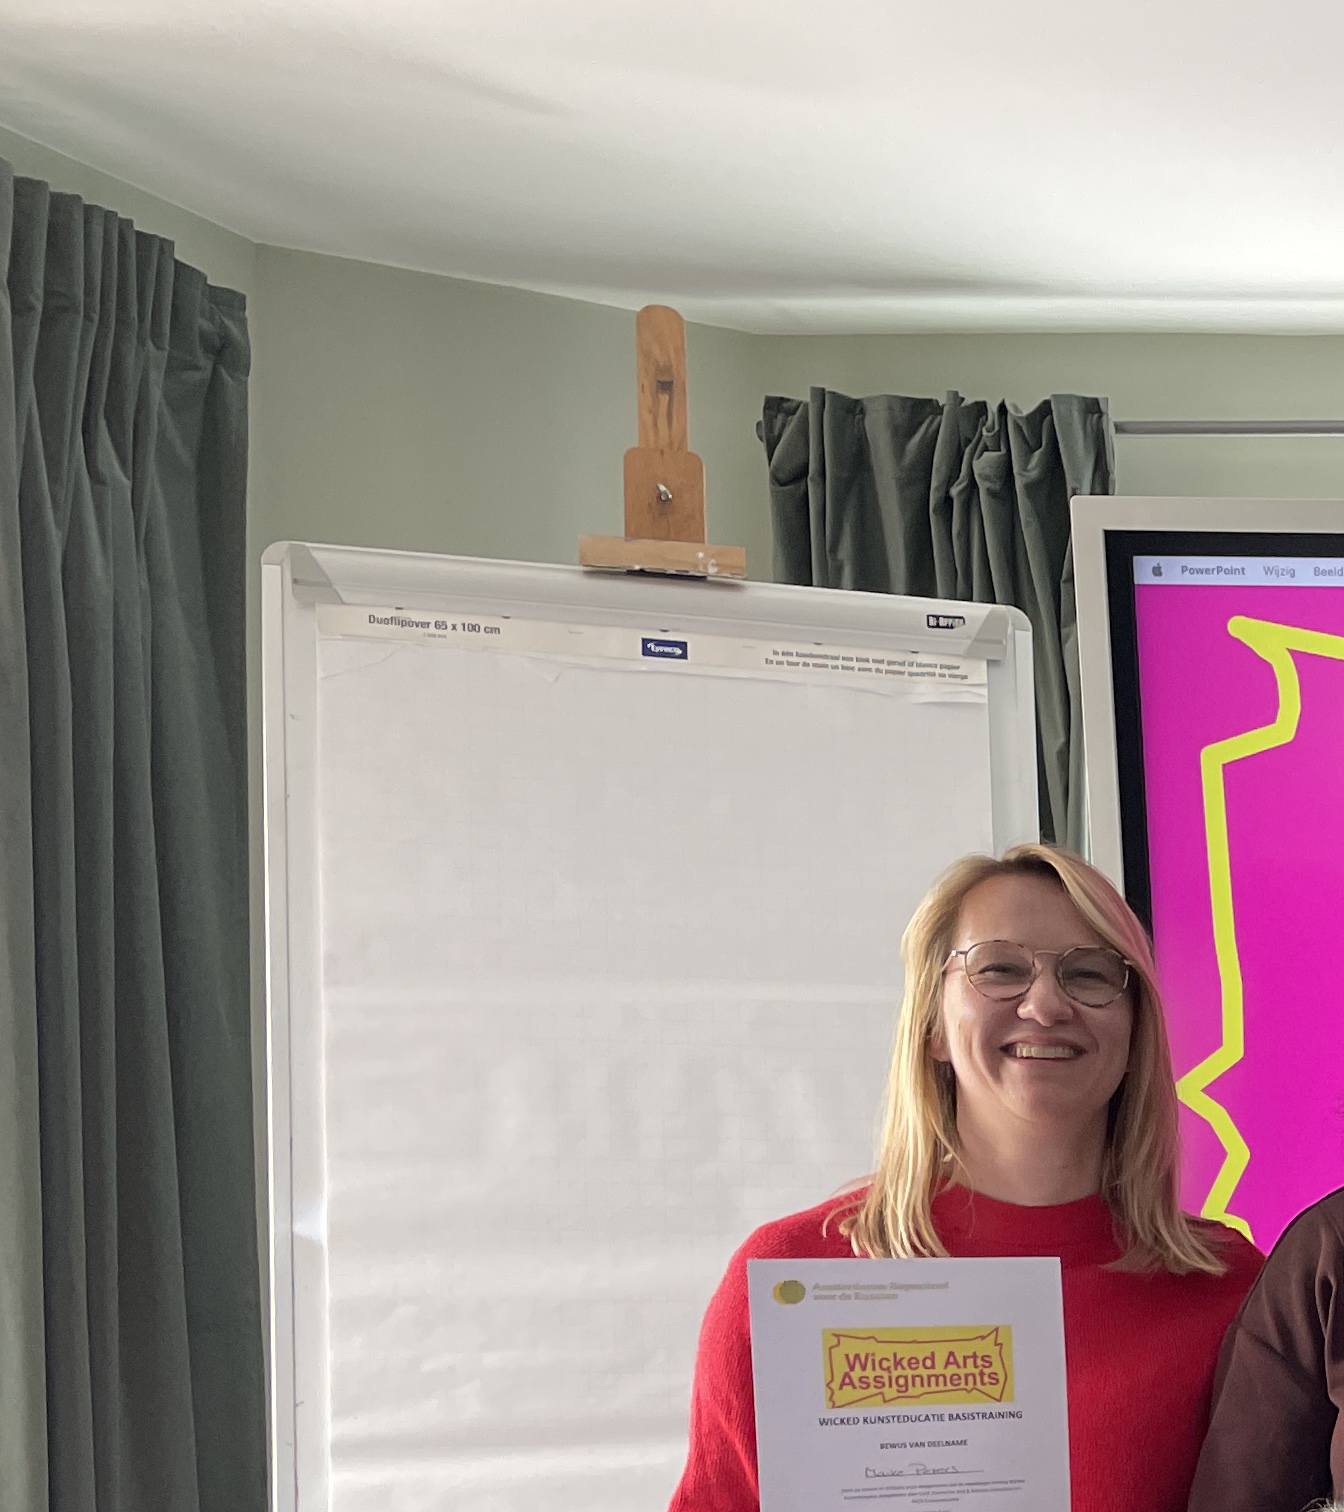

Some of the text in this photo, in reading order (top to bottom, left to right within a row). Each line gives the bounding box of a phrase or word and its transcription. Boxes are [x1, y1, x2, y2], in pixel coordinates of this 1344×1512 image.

[1181, 565, 1246, 576] PowerPoint
[1263, 566, 1296, 579] Wijzig
[1313, 566, 1344, 577] Beeld
[368, 614, 501, 634] Duoflipover 65 x 100 cm
[845, 1350, 993, 1374] Wicked Arts
[838, 1369, 1000, 1393] Assignments
[818, 1410, 1023, 1427] WICKED KUNSTEDUCATIE BASISTRAINING
